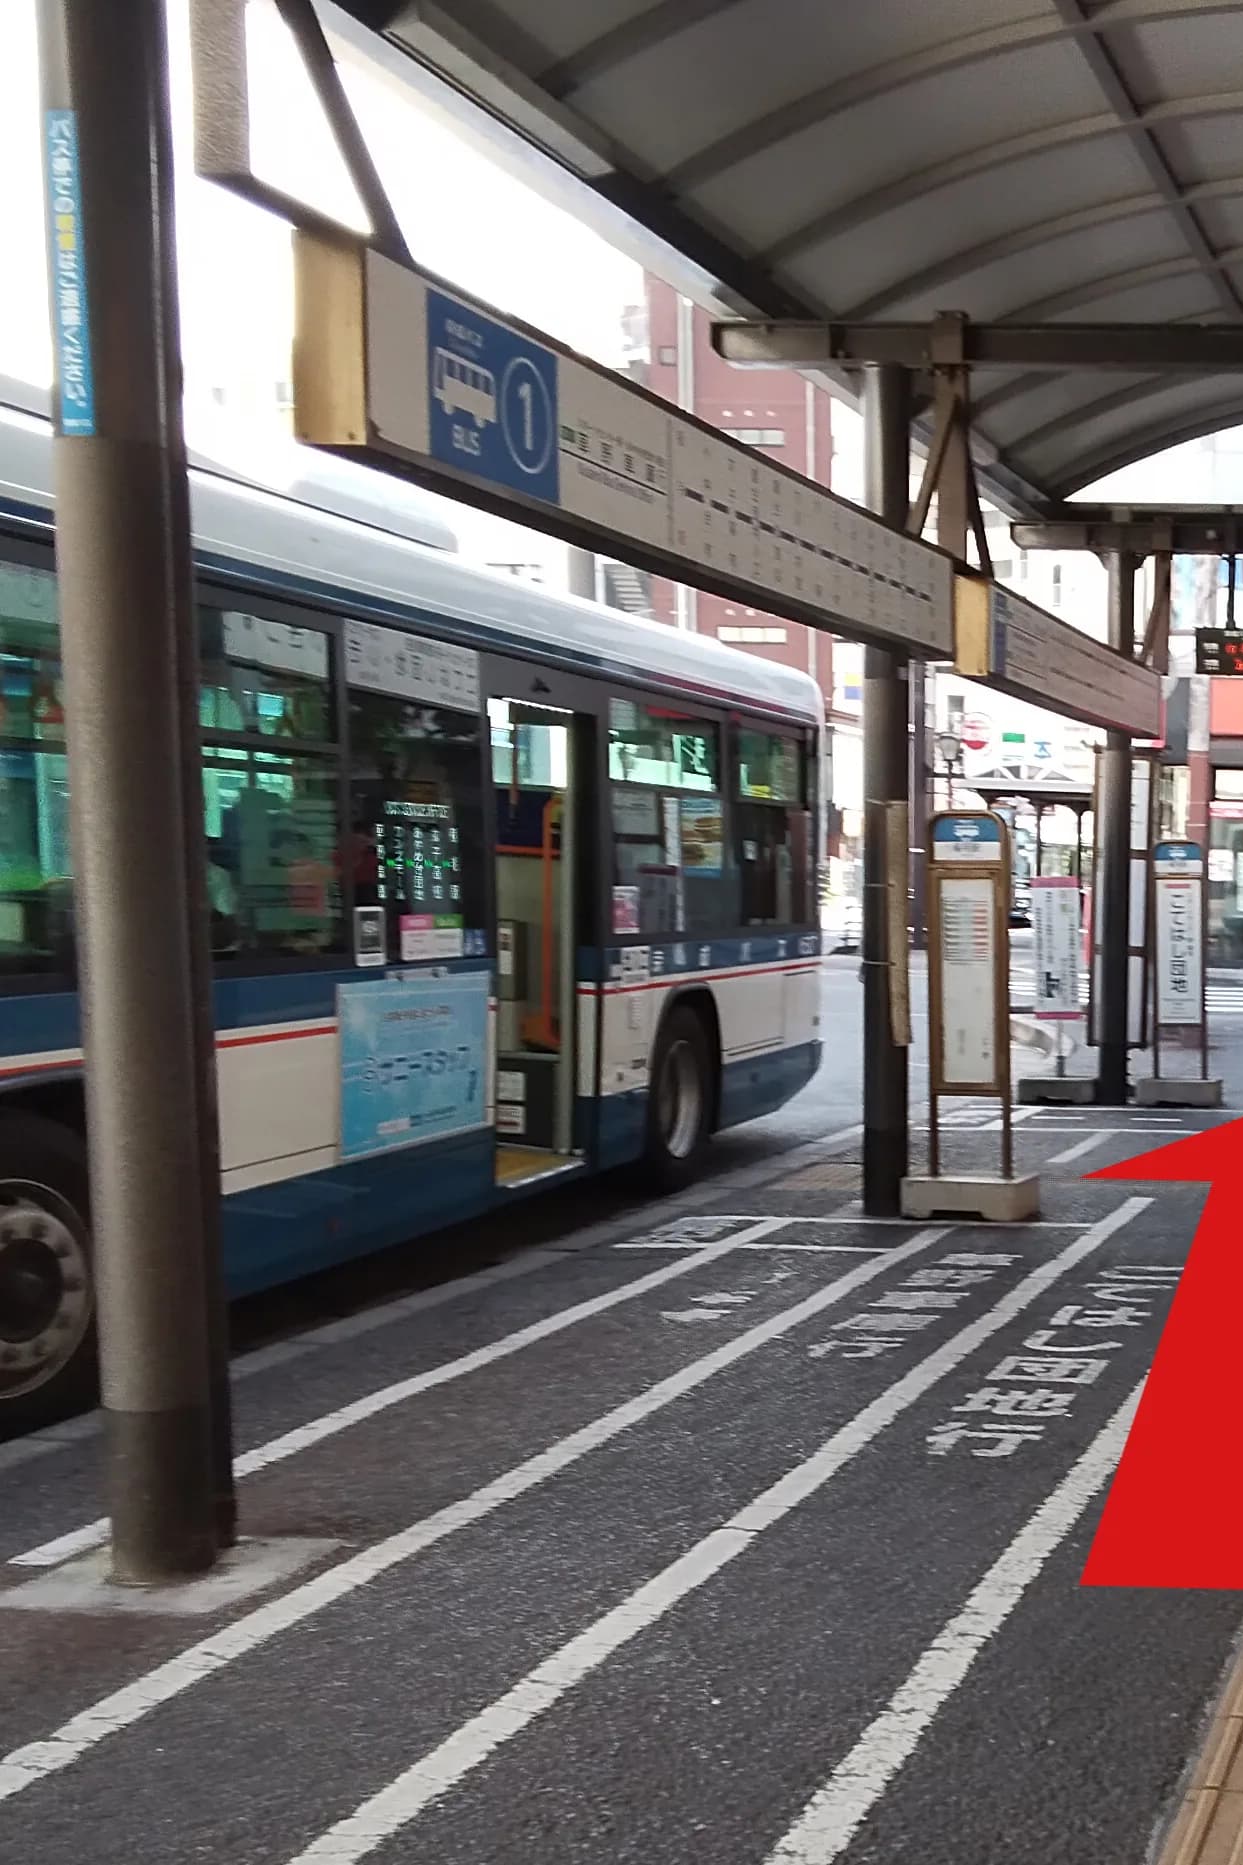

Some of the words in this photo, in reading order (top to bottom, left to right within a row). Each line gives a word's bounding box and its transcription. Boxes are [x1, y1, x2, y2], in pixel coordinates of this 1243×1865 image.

[452, 423, 482, 456] BUS
[926, 1265, 1185, 1457] こてはし団地行
